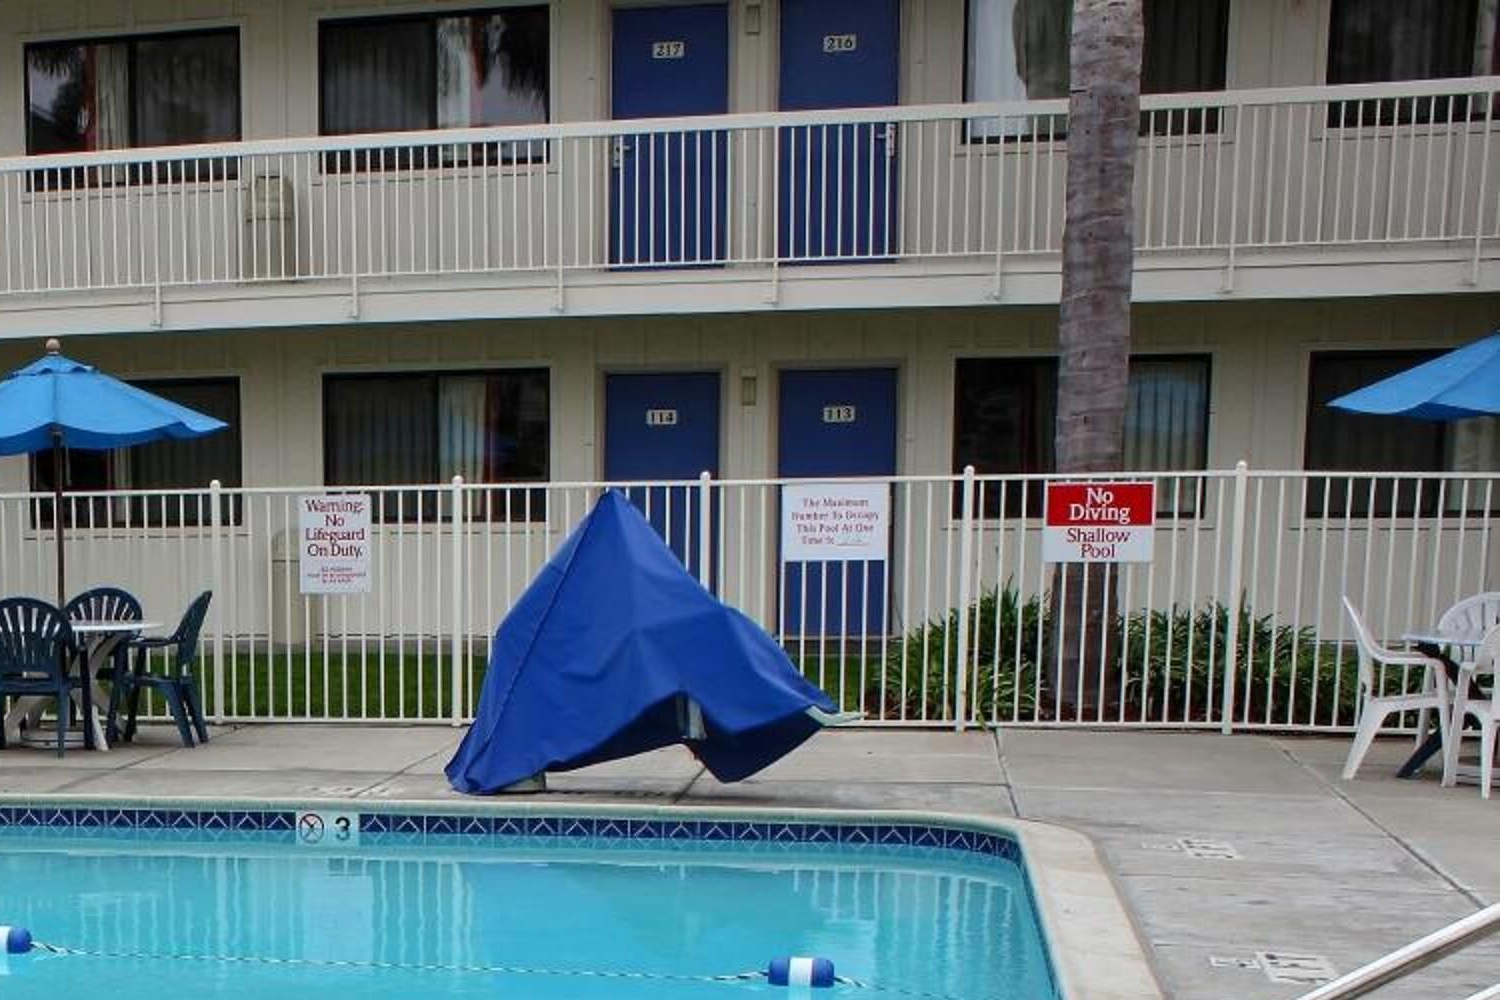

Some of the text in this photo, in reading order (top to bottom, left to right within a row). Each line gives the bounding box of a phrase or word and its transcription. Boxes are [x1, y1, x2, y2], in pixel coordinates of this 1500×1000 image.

[826, 36, 854, 50] 216
[826, 407, 852, 421] 113
[823, 497, 869, 507] Maximum
[1086, 486, 1114, 505] No
[325, 514, 345, 527] No
[791, 511, 829, 521] Number
[1068, 503, 1131, 525] Diving
[797, 523, 874, 533] This Pool At One
[1066, 527, 1131, 543] Shallow
[305, 528, 365, 545] Lifeguard
[307, 543, 327, 557] On
[1080, 543, 1116, 559] Pool
[335, 816, 350, 837] 3
